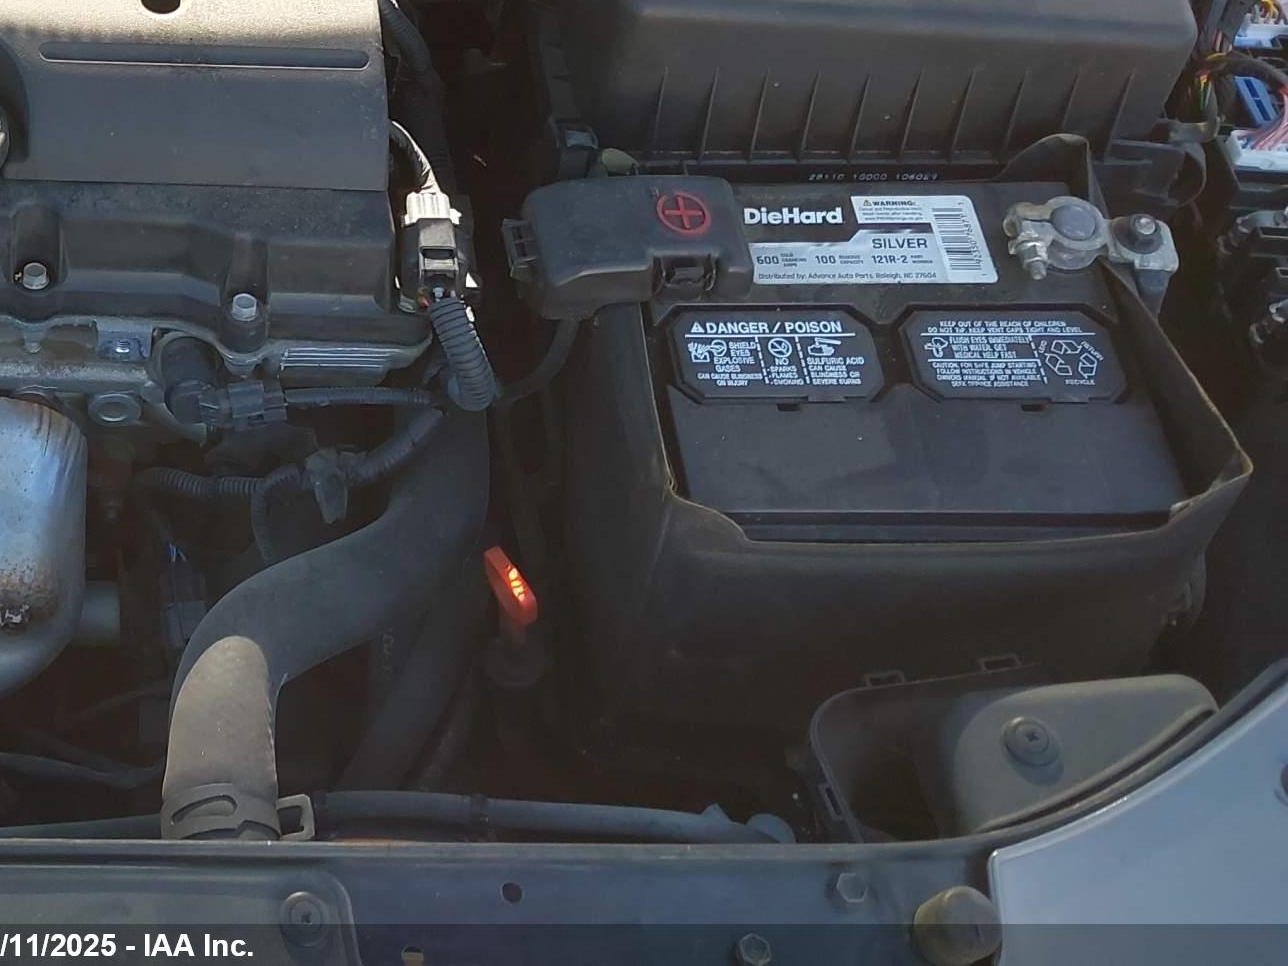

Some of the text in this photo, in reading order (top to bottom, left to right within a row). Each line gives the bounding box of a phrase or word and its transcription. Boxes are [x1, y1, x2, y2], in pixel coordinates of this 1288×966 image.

[743, 207, 842, 225] DieHard
[872, 238, 928, 249] SILVER
[756, 255, 779, 265] 600
[815, 255, 836, 264] 100
[872, 255, 909, 264] 121R-2
[706, 321, 843, 334] DANGER / POISON
[949, 336, 1030, 344] FLUSH EYES IMMEDIATELY
[730, 349, 751, 357] EYES
[714, 356, 756, 364] EXPLOSIVE
[775, 357, 789, 366] NO
[806, 357, 864, 365] SULFURIC ACID
[715, 364, 741, 373] GASES
